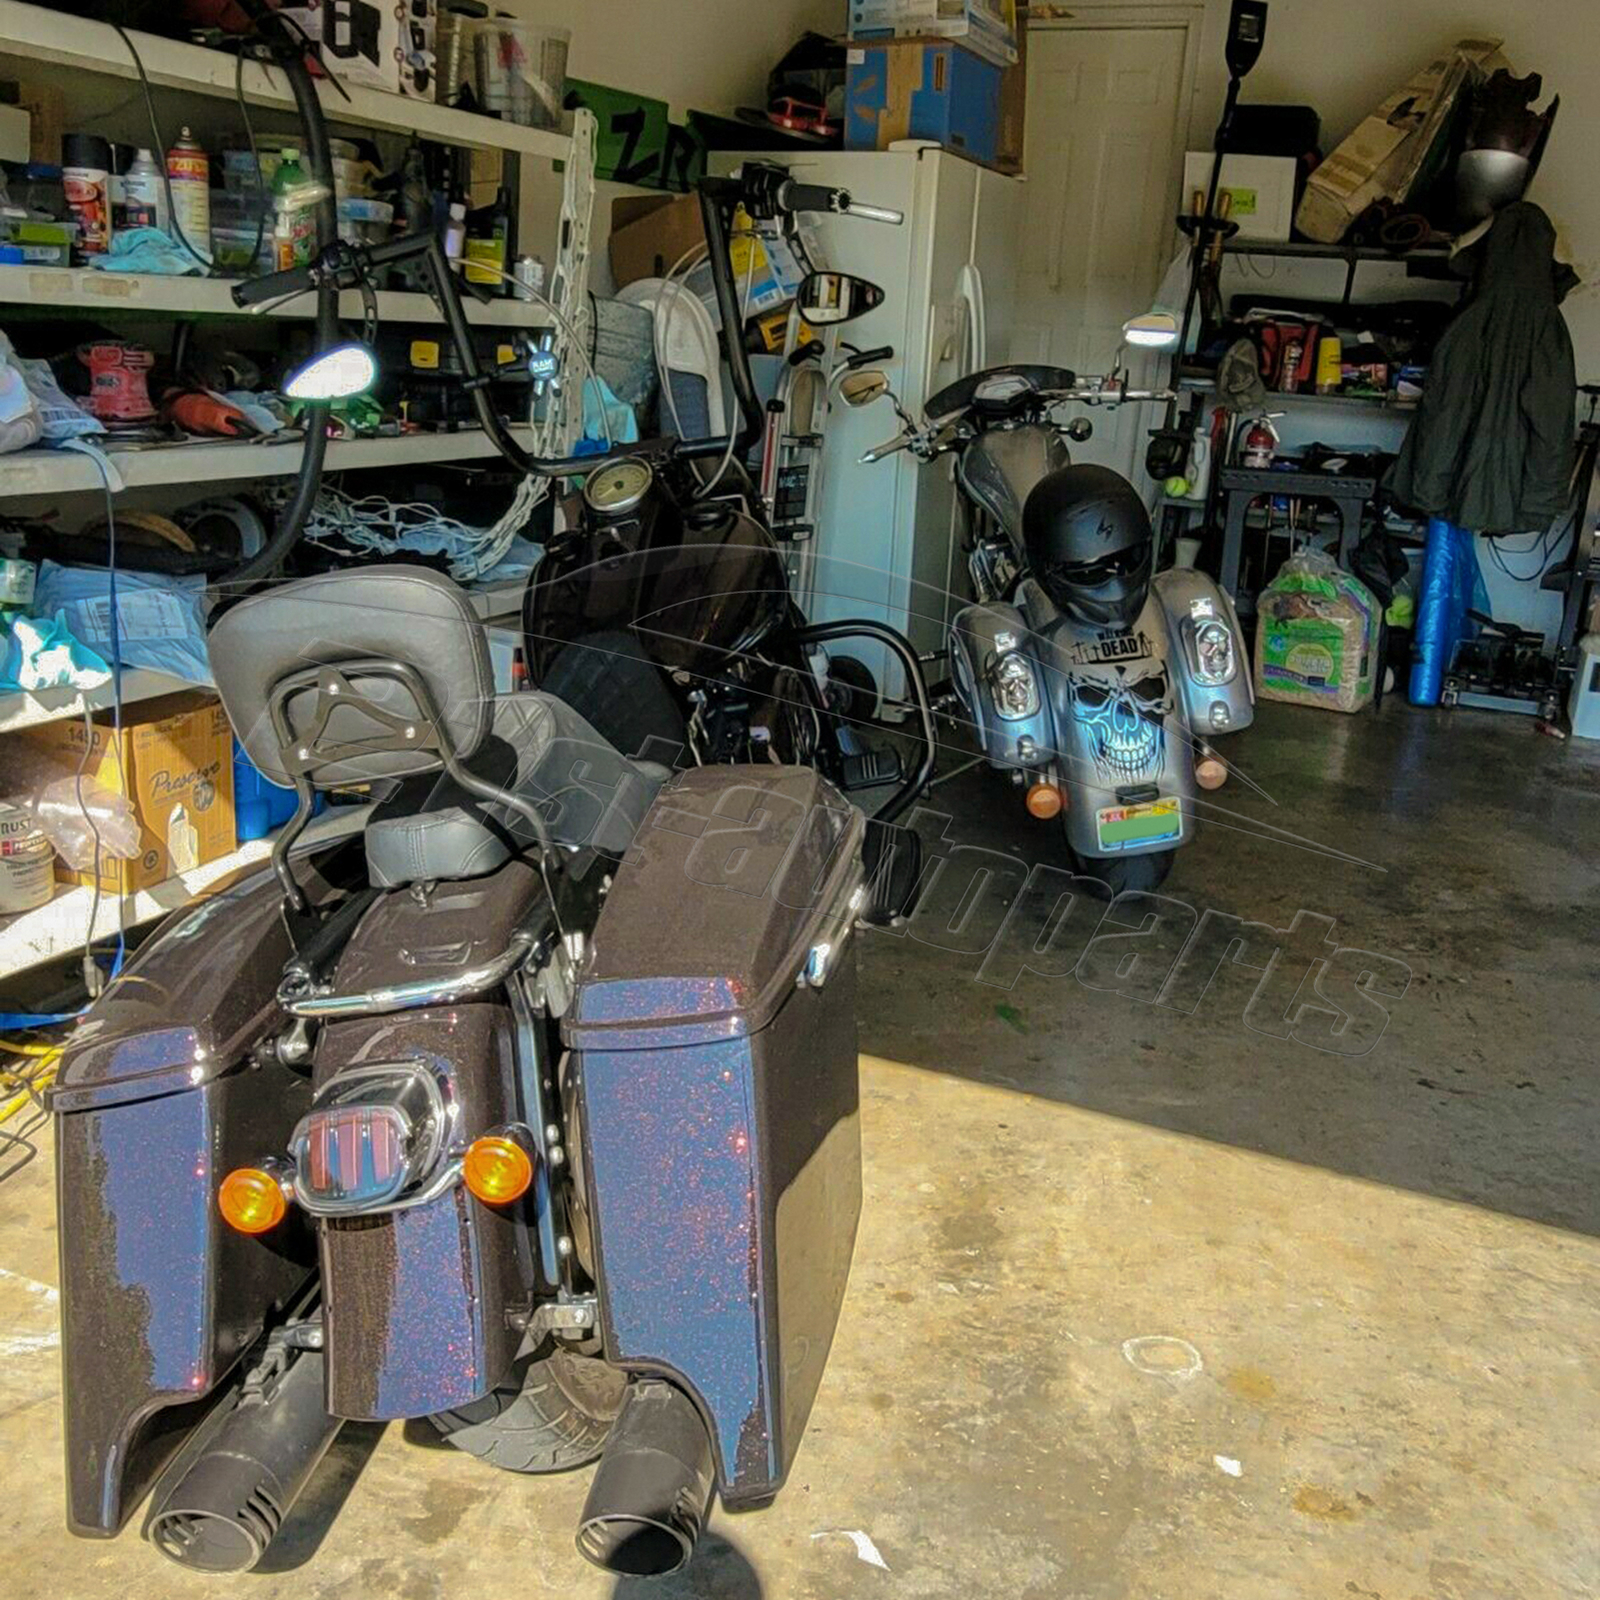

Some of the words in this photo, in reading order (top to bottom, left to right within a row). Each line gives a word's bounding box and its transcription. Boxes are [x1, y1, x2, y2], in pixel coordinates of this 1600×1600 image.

[1101, 638, 1138, 657] DEAD
[68, 726, 101, 746] 140
[1, 818, 31, 835] RUST
